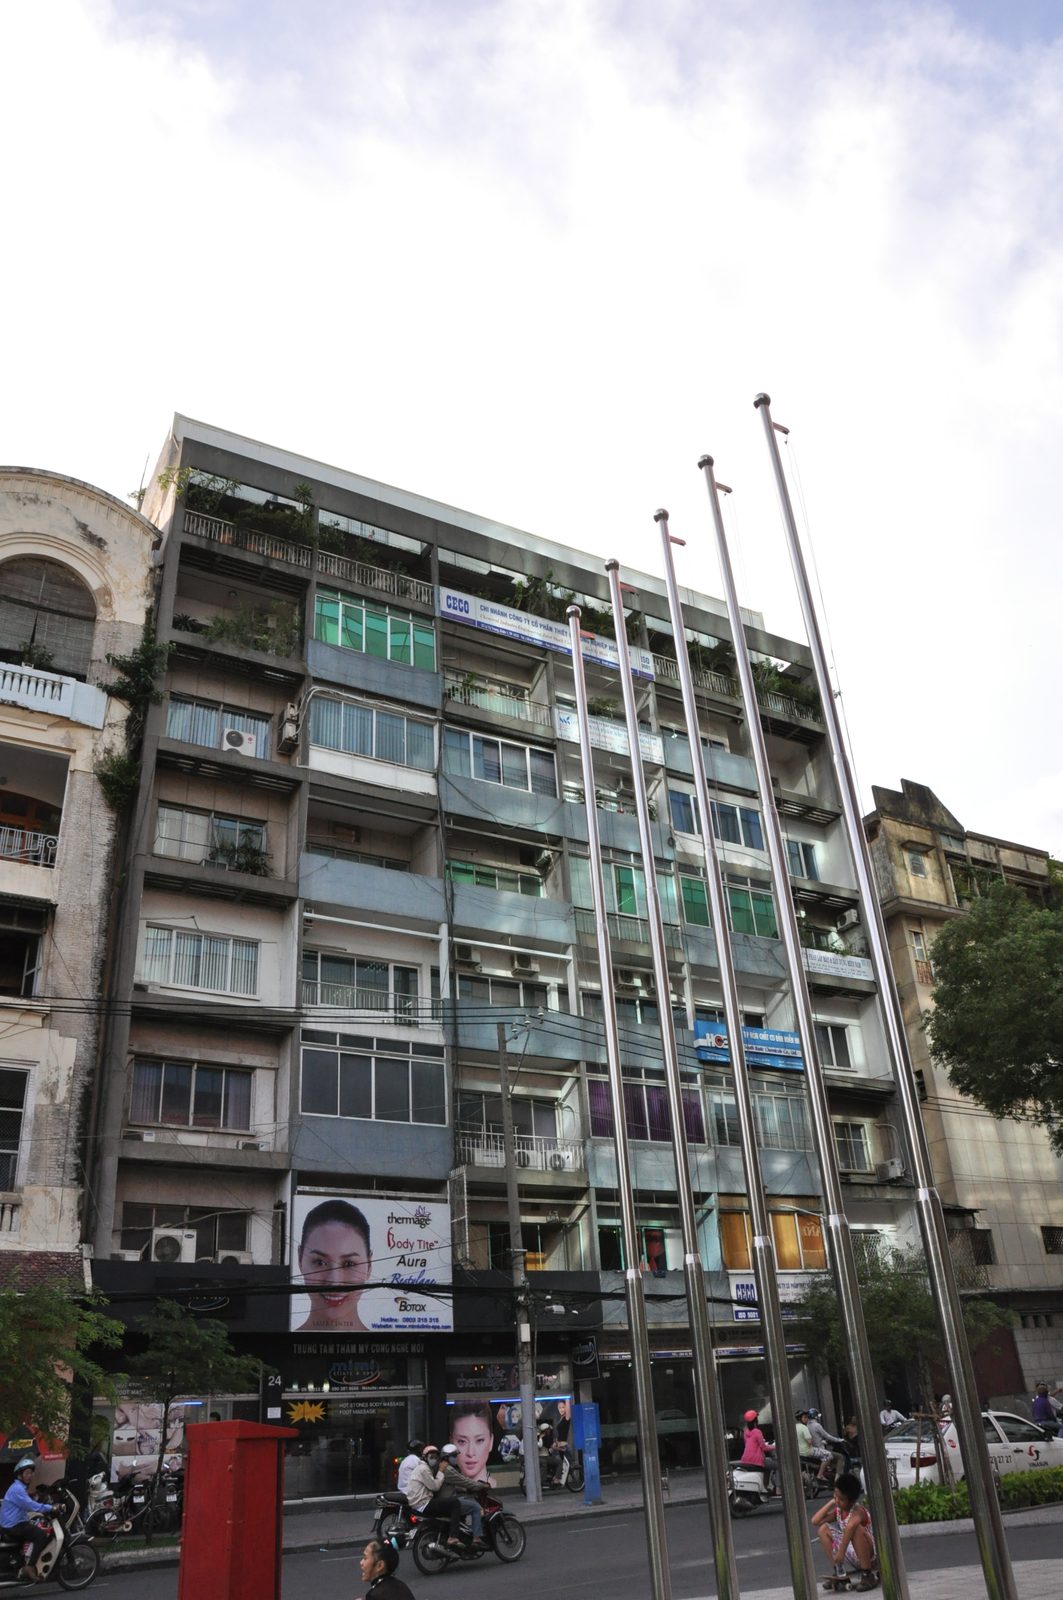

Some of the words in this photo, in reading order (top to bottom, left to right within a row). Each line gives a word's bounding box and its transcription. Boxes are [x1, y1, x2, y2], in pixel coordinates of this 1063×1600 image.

[446, 594, 470, 614] CECO
[479, 604, 490, 613] CHI
[490, 606, 508, 618] NHÁNH
[508, 612, 523, 623] CÔNG
[524, 616, 531, 626] TY
[387, 1212, 432, 1229] thermage
[387, 1227, 414, 1252] Body
[396, 1255, 427, 1267] Aura
[738, 1311, 746, 1319] ISO
[747, 1311, 759, 1319] 9001
[268, 1376, 282, 1386] 24
[997, 1455, 1004, 1464] 27
[1005, 1455, 1012, 1463] 27
